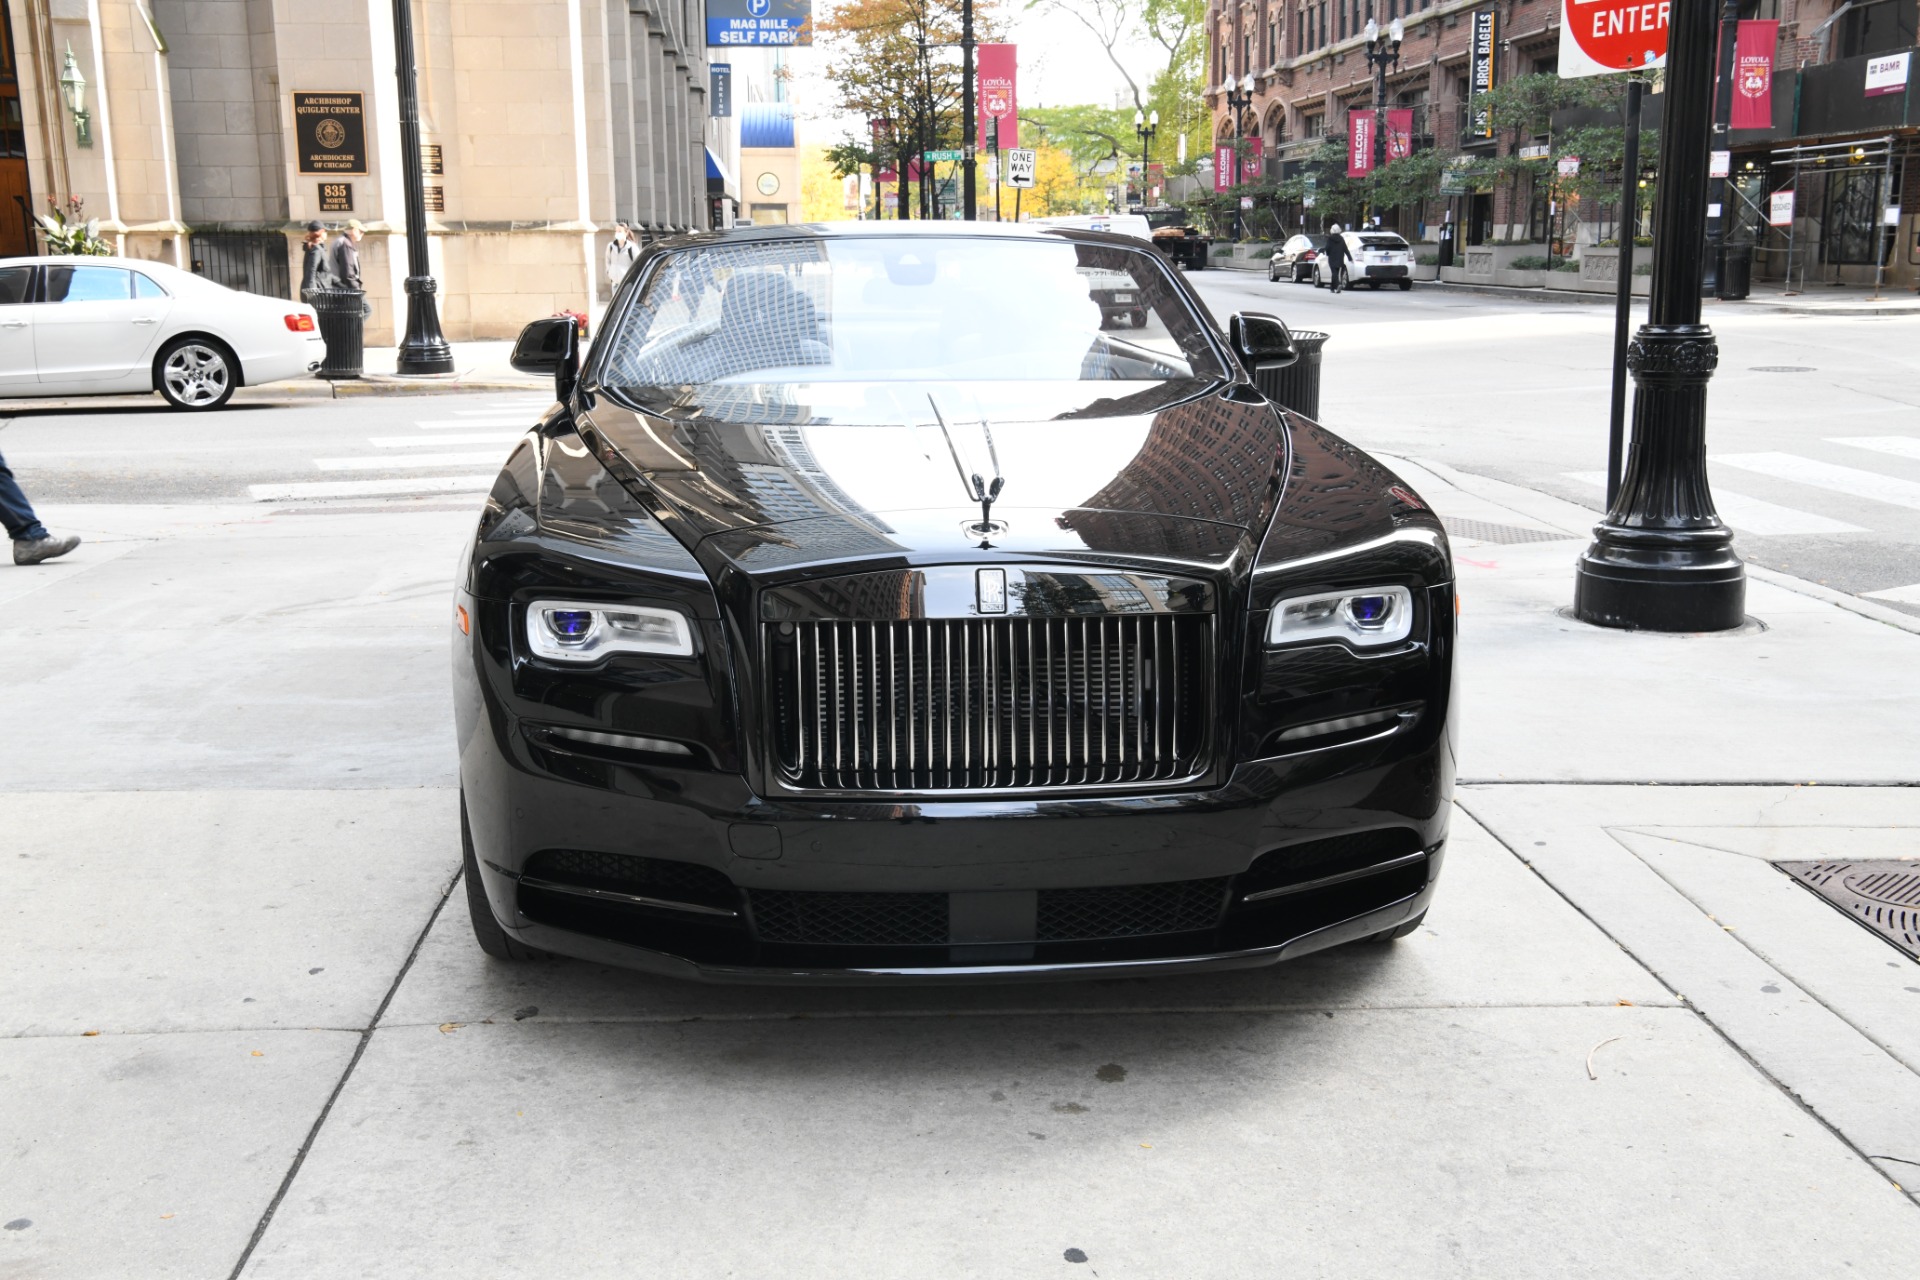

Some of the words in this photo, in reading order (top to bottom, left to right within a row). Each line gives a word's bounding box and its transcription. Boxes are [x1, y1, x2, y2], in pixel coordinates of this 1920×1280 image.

[730, 19, 757, 29] MAG
[760, 19, 788, 29] MILE
[1592, 1, 1670, 38] ENTER
[719, 31, 756, 43] SELF
[759, 31, 798, 43] PARK
[1478, 14, 1492, 54] BAGELS
[1741, 56, 1770, 64] LOYOLA
[1477, 57, 1490, 86] BROS.
[1880, 61, 1900, 73] BAMR
[304, 97, 352, 105] ARCHBISHOP
[297, 106, 330, 114] QUIGLEY
[330, 106, 360, 114] CENTER
[1355, 118, 1364, 169] WELCOME
[931, 152, 953, 160] RUSH
[1011, 152, 1032, 162] ONE
[1011, 163, 1032, 173] WAY
[1219, 148, 1227, 187] WELCOME
[324, 185, 347, 197] 835
